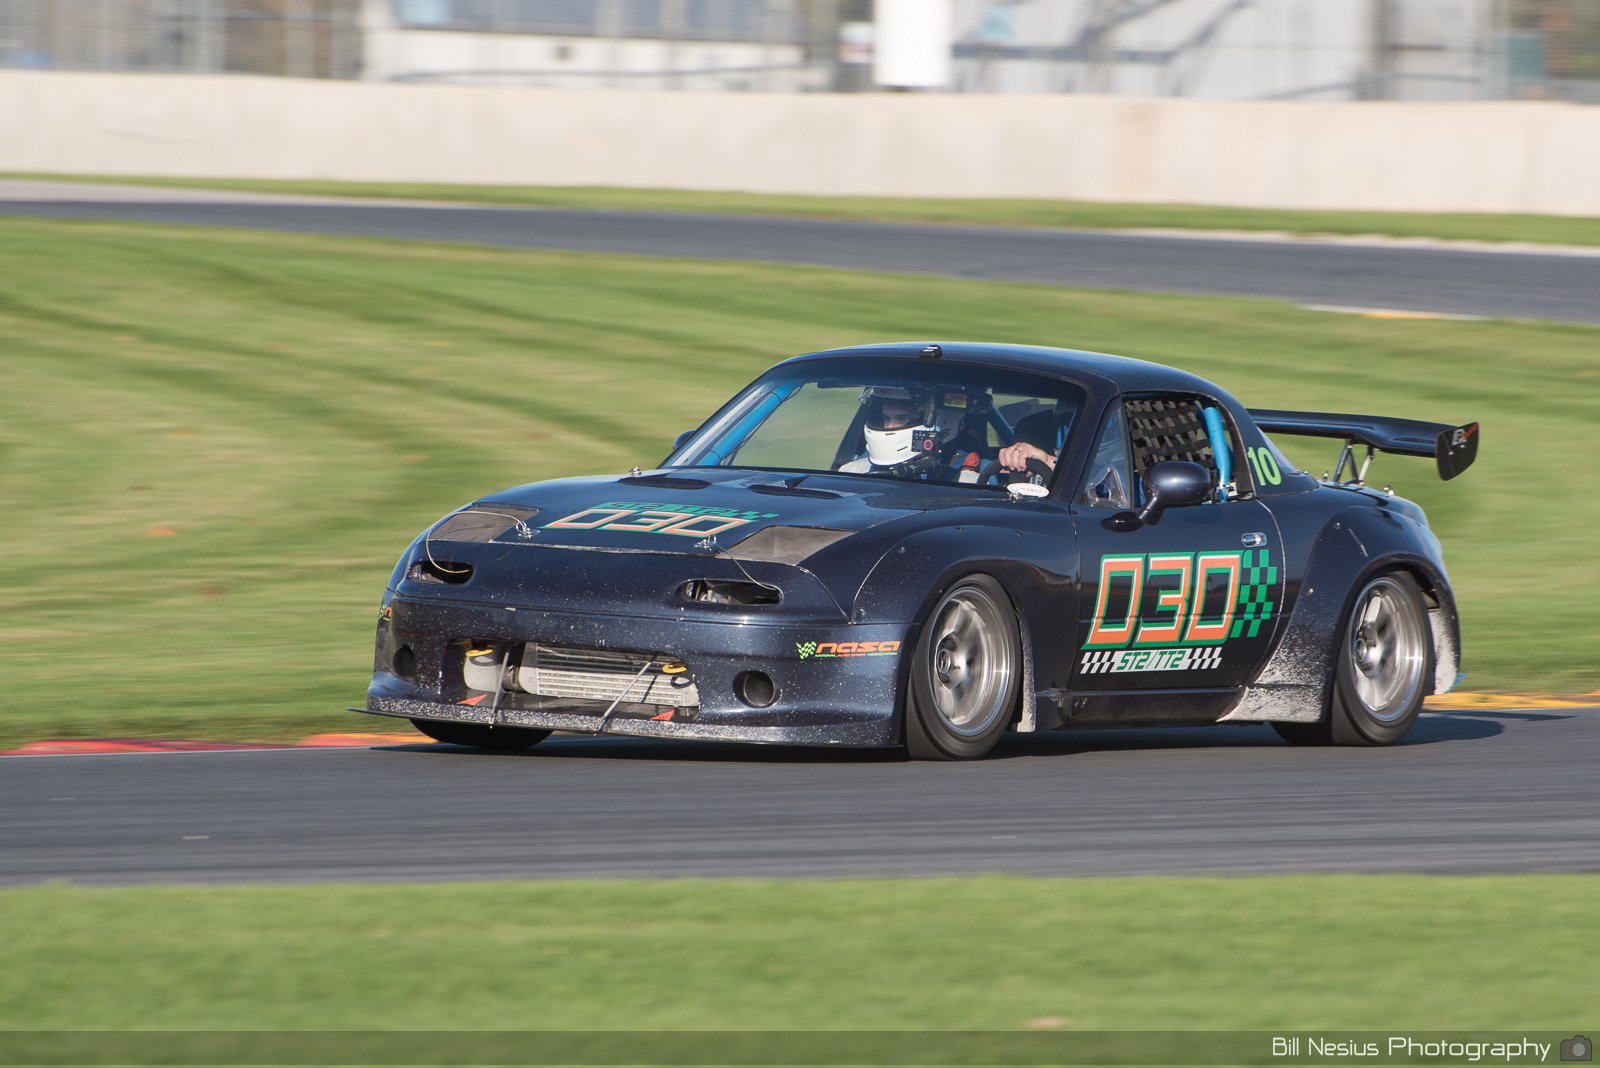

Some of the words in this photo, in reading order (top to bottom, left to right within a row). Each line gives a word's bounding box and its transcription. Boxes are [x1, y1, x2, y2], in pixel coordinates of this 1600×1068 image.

[1247, 447, 1282, 486] 10
[541, 509, 757, 537] 030
[1082, 551, 1244, 649] 030
[816, 641, 901, 653] nasa
[1116, 650, 1187, 670] ST2/TT2
